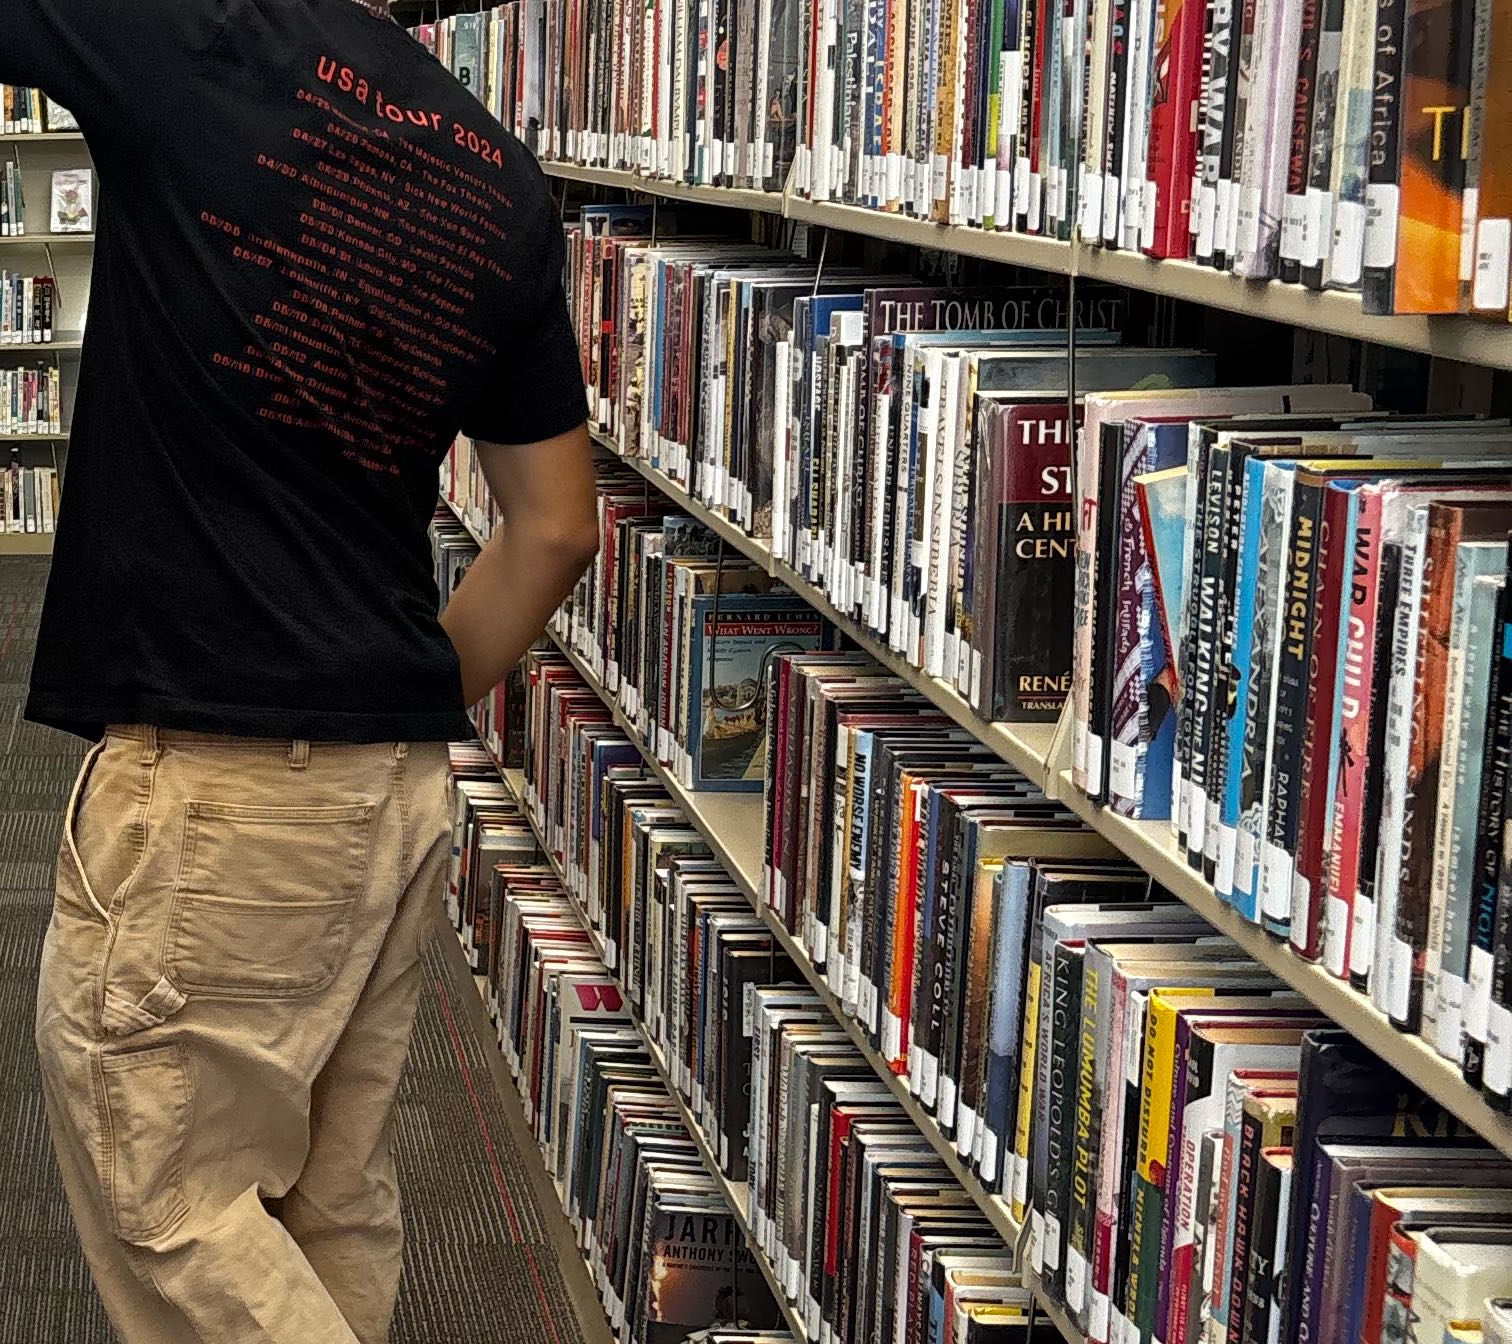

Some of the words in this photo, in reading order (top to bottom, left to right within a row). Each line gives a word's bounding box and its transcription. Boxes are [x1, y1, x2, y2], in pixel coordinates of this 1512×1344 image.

[1376, 25, 1398, 59] of
[316, 55, 368, 104] usa
[376, 90, 441, 130] tour
[453, 122, 503, 170] 2024
[844, 32, 858, 139] Palestinians
[1370, 72, 1395, 167] Africa
[882, 299, 924, 332] THE
[930, 299, 995, 331] TOMB
[1002, 298, 1034, 330] OF
[904, 363, 913, 398] NINE
[900, 401, 911, 474] QUARTERS
[1206, 469, 1223, 554] LEVISON
[1288, 516, 1313, 661] MIDNIGHT
[1349, 526, 1371, 606] WAR
[1399, 543, 1417, 597] THREE
[707, 623, 739, 636] WHAT
[741, 624, 773, 636] WENT
[774, 624, 819, 637] WRONG?
[1394, 601, 1412, 676] EMPIRES
[1018, 669, 1072, 692] RENÉ
[1340, 615, 1365, 719] CHILD
[853, 753, 866, 772] NO
[1486, 745, 1511, 841] HISTORY
[852, 776, 865, 822] WORSE
[850, 825, 865, 871] ENEMY
[936, 860, 949, 947] STEVE
[930, 962, 943, 1032] COLL
[1040, 951, 1053, 1021] AFRICA'S
[1054, 957, 1071, 1027] KING
[1085, 968, 1099, 1025] THE
[1038, 1028, 1050, 1083] WORLD
[1147, 1014, 1158, 1039] DO
[1076, 1029, 1098, 1141] LUMUMBA
[1144, 1044, 1156, 1081] NOT
[1037, 1089, 1047, 1122] WAR
[1047, 1039, 1067, 1182] LEOPOLD'S
[1138, 1089, 1153, 1166] DISTURB
[1073, 1147, 1090, 1208] PLOT
[1179, 1139, 1196, 1232] OPERATION
[1239, 1123, 1255, 1197] BLACK
[663, 1244, 725, 1263] ANTHONY
[1234, 1206, 1248, 1268] HAWK
[1229, 1279, 1243, 1343] DOWN
